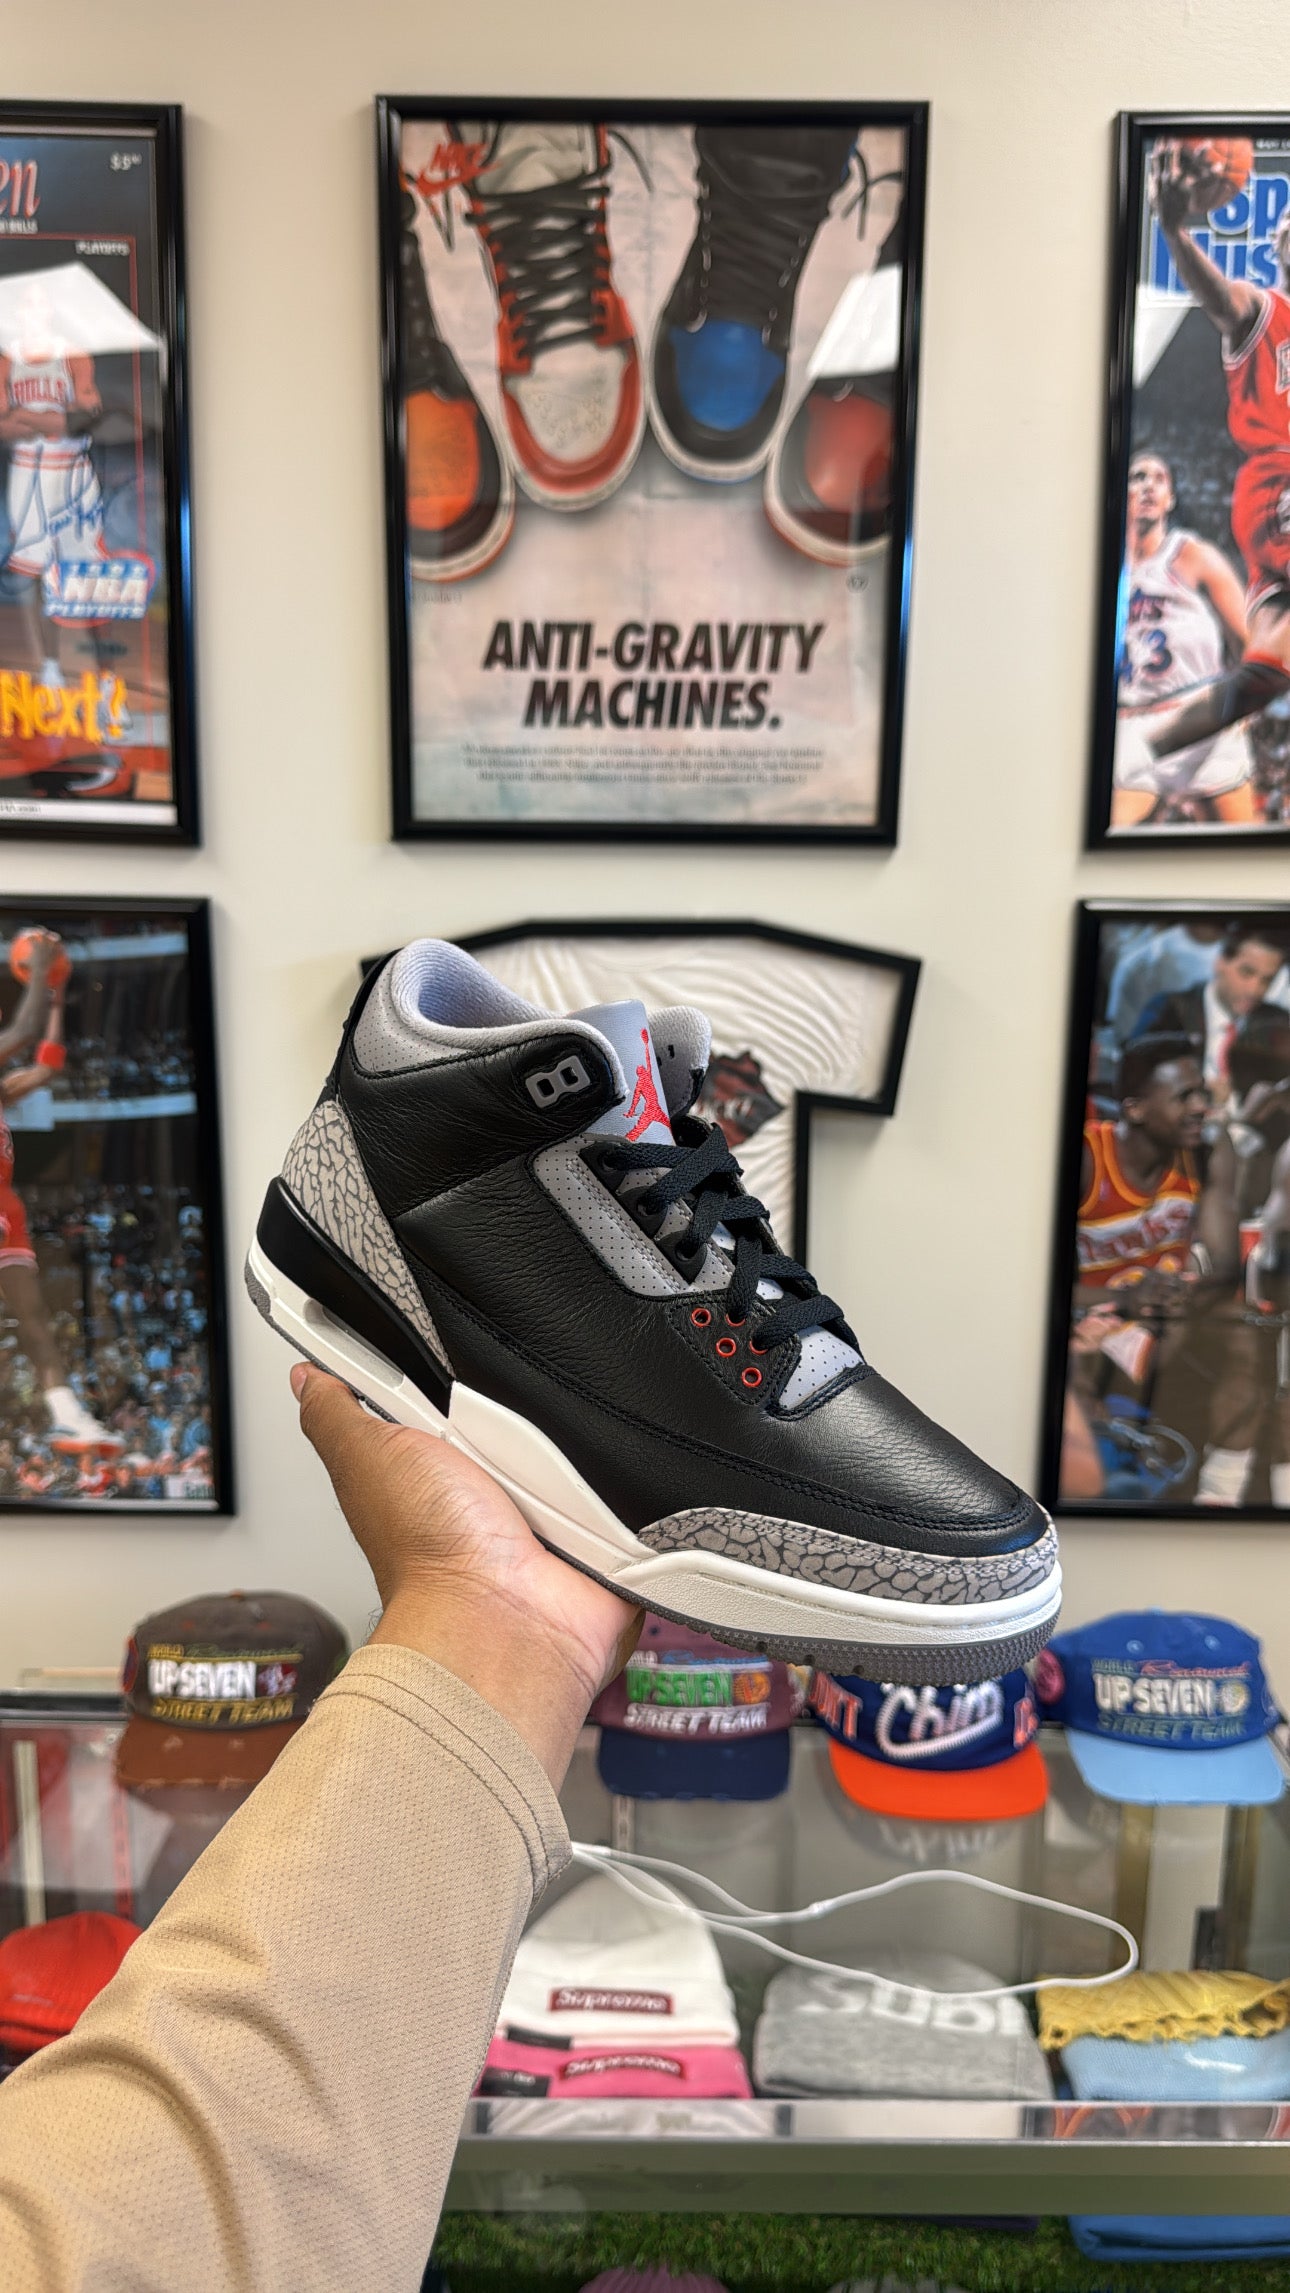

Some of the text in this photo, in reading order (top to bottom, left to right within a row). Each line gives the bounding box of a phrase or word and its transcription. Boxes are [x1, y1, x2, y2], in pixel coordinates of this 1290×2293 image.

[63, 577, 148, 603] NBA
[47, 603, 146, 619] PLAYOFFS
[482, 620, 825, 673] ANTI-GRAVITY
[523, 680, 784, 730] MACHINES.
[151, 1697, 294, 1724] STREET TEAM
[623, 1702, 706, 1735] STREET
[707, 1703, 770, 1734] TEAM
[1098, 1713, 1246, 1741] STREET TEAM
[554, 1987, 669, 2011] Supreme
[563, 2053, 682, 2077] Supreme
